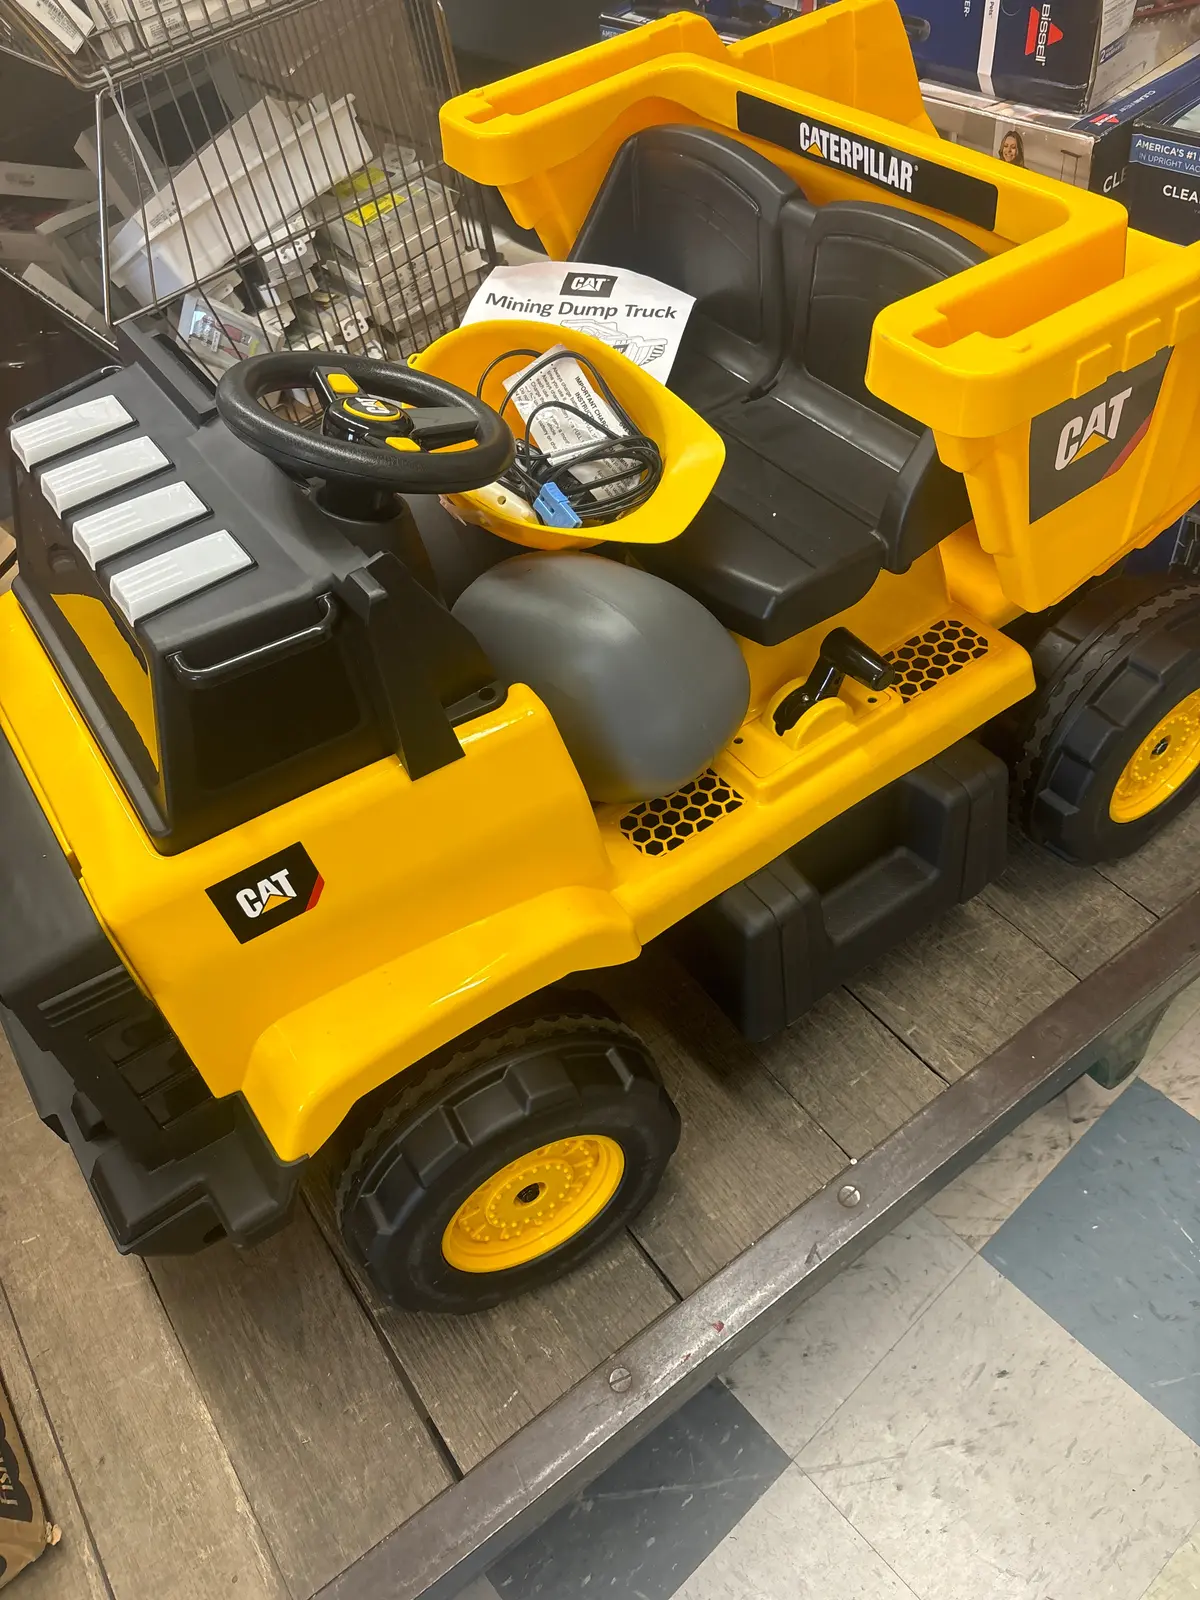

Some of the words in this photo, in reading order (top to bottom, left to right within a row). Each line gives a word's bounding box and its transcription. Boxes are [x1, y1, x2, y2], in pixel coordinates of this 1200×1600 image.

[799, 121, 914, 194] CATERPILLAR
[1135, 139, 1185, 159] AMERICA'S
[1186, 150, 1197, 161] #1
[1147, 155, 1183, 169] UPRIGHT
[1162, 184, 1200, 204] CLEA
[570, 276, 606, 292] CAT
[485, 292, 554, 318] Mining
[557, 301, 618, 320] Dump
[624, 303, 678, 319] Truck
[573, 375, 597, 409] IMPORTANT
[356, 397, 390, 414] CAT
[1054, 386, 1133, 471] CAT
[236, 868, 297, 918] CAT
